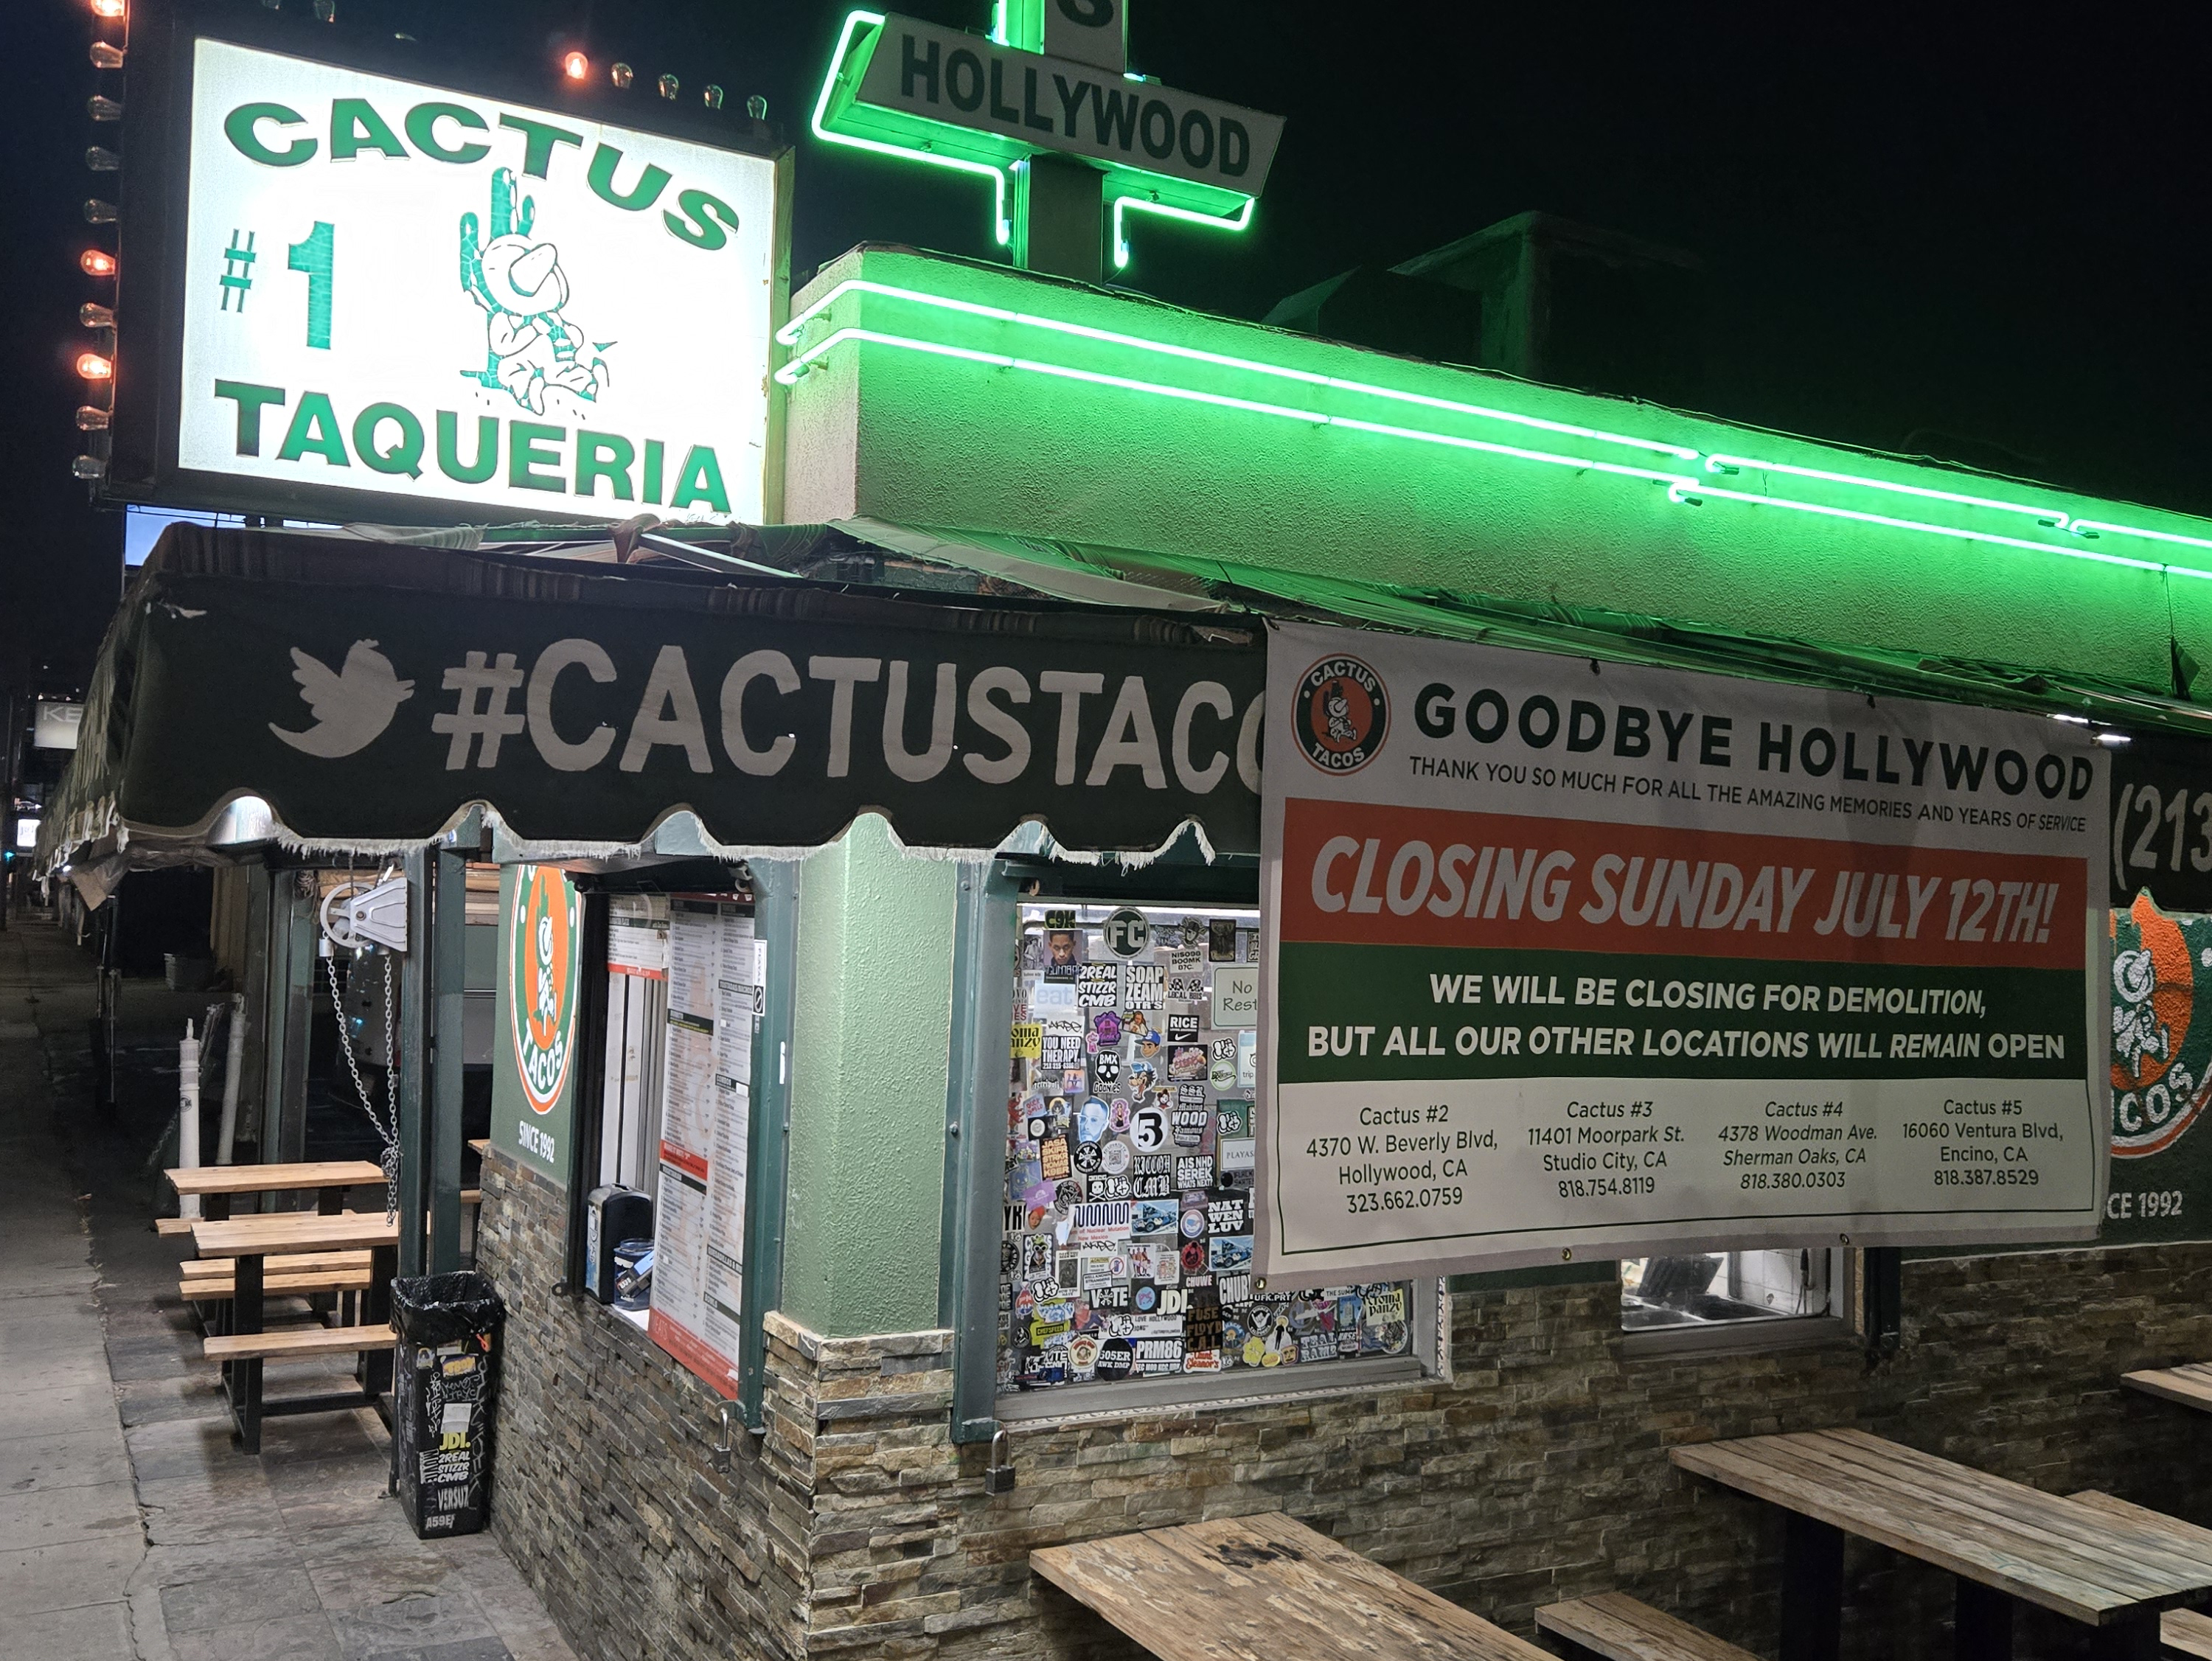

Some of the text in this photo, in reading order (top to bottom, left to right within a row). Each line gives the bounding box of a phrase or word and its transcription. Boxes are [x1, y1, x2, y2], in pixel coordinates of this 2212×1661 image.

[901, 35, 1251, 178] HOLLYWOOD
[224, 97, 739, 251] CACTUS
[214, 378, 732, 515] TAQUERIA
[1310, 661, 1376, 692] CACTUS
[1414, 683, 2093, 801] GOODBYE HOLLYWOOD
[1312, 742, 1365, 768] TACOS
[1409, 756, 2087, 833] THANK YOU SO MUCH FOR ALL THE AMAZING MEMORIES AND YEARS OF SERVICE
[1312, 835, 2059, 944] CLOSING SUNDAY JULY 12TH!
[1108, 920, 1147, 948] FC
[1079, 965, 1117, 979] 2REAL
[1126, 967, 1164, 983] SOAP
[1079, 981, 1116, 994] STIZZR
[1125, 983, 1163, 1001] ZEAM
[1233, 981, 1253, 994] No
[1430, 974, 1986, 1020] WE WILL BE CLOSING FOR DEMOLITION,
[1079, 995, 1116, 1007] CMB
[1170, 1017, 1197, 1028] RICE
[1043, 1037, 1080, 1049] YOU NEED
[1308, 1025, 2065, 1059] BUT ALL OUR OTHER LOCATIONS WILL REMAIN OPEN
[523, 1017, 563, 1090] TACOS
[1099, 1054, 1118, 1065] BMX
[1944, 1098, 2023, 1115] Cactus #5
[2111, 1062, 2194, 1132] COS
[1360, 1104, 1449, 1126] Cactus #2
[1567, 1101, 1654, 1119] Cactus #3
[1765, 1100, 1843, 1118] Cactus #4
[1172, 1112, 1208, 1127] WOOD
[1528, 1126, 1686, 1150] 11401 Moorpark St.
[1718, 1123, 1877, 1142] 4378 Woodman Ave.
[1902, 1121, 2064, 1142] 16060 Ventura Blvd,
[518, 1119, 555, 1164] SINCE 1992
[1306, 1129, 1498, 1159] 4370 W. Beverly Blvd,
[1544, 1151, 1668, 1174] Studio City, CA
[1724, 1147, 1866, 1167] Sherman Oaks, CA
[1940, 1146, 2028, 1165] Encino, CA
[1178, 1168, 1213, 1180] SEREK
[1339, 1160, 1468, 1185] Hollywood, CA
[1740, 1171, 1846, 1190] 818.380.0303
[1934, 1168, 2039, 1187] 818.387.8529
[1558, 1177, 1655, 1198] 818.754.8119
[1208, 1199, 1244, 1213] NAT
[1346, 1186, 1464, 1214] 323.662.0759
[2138, 1190, 2183, 1218] 1992
[1208, 1221, 1244, 1233] LUV
[1188, 1307, 1219, 1321] FUSE
[1187, 1321, 1222, 1337] FLOYD
[1136, 1340, 1182, 1359] PRM86
[439, 1432, 471, 1450] JDI.
[438, 1451, 470, 1463] 2REAL
[437, 1472, 468, 1483] CMB
